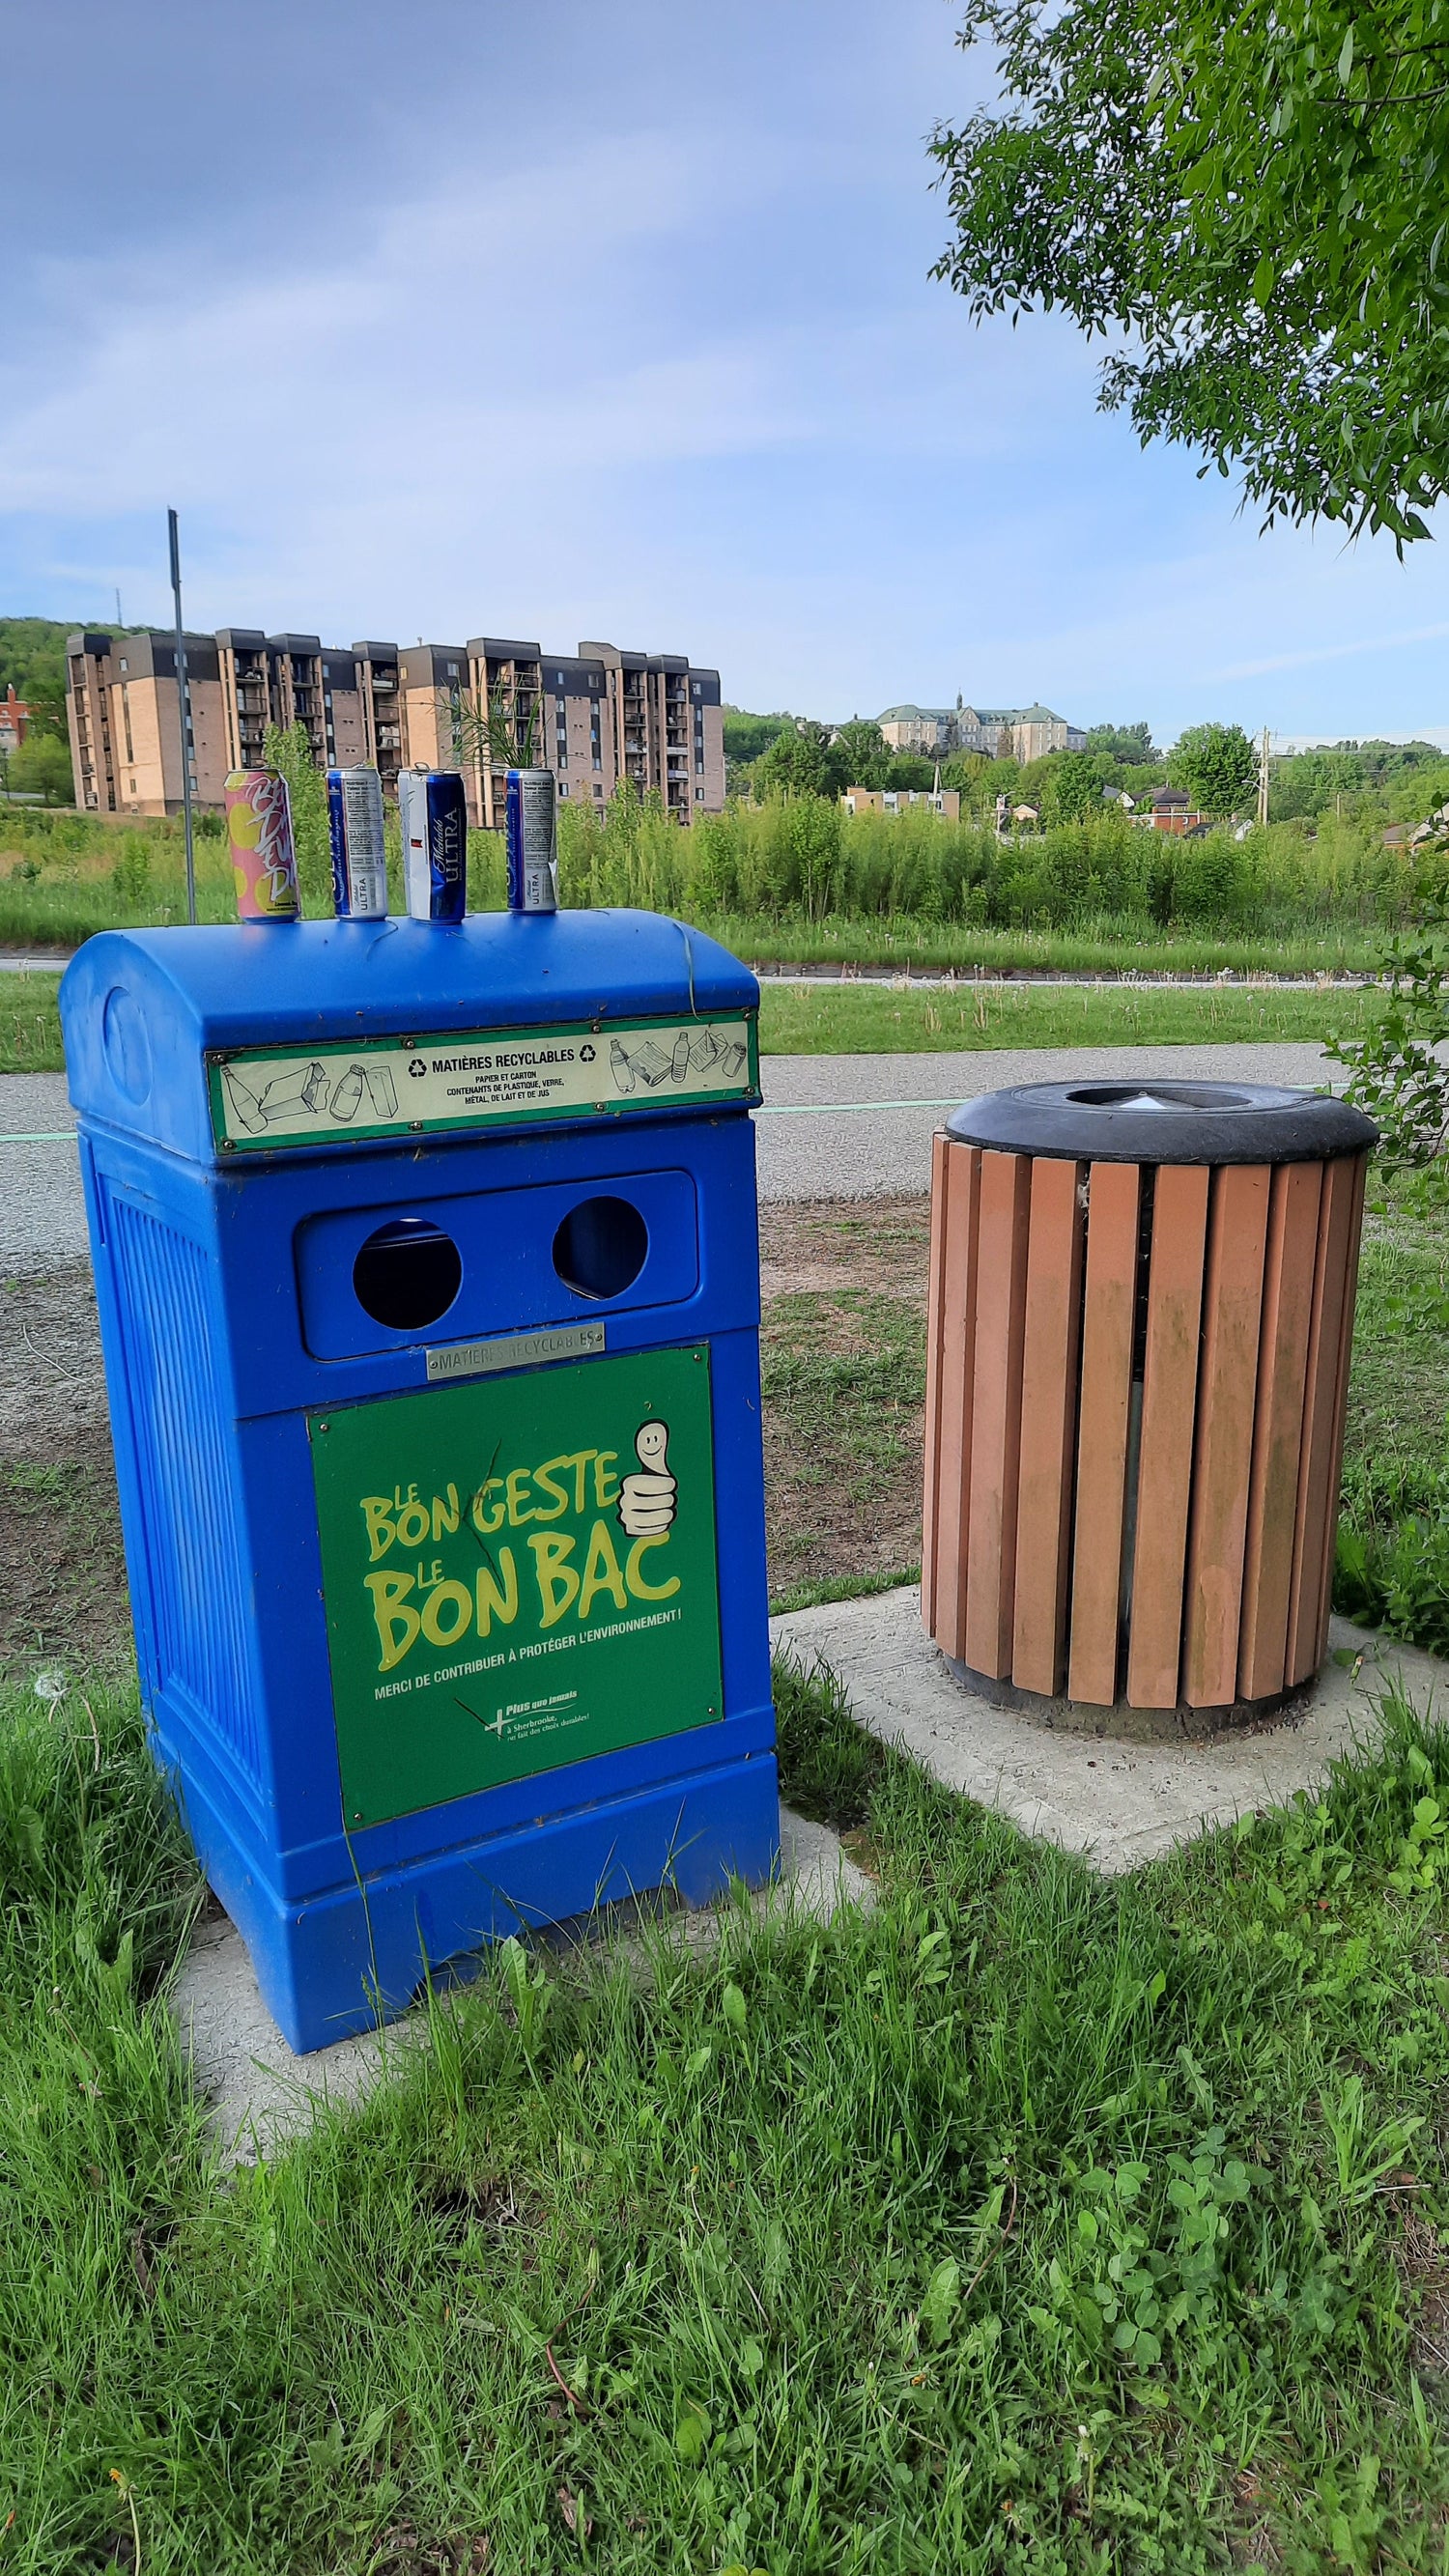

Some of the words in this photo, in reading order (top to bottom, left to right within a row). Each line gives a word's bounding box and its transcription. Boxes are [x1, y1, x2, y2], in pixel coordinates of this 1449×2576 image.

[444, 807, 459, 883] ULTRA
[358, 877, 368, 911] ULTRA
[432, 1056, 493, 1073] MATIÈRES
[496, 1049, 575, 1068] RECYCLABLES
[446, 1085, 492, 1096] CONTENANTS
[493, 1084, 502, 1092] DE
[503, 1081, 541, 1091] PLASTIQUE,
[542, 1078, 565, 1088] VERRE,
[475, 1073, 499, 1084] PAPIER
[501, 1073, 509, 1082] ET
[510, 1071, 537, 1081] CARTON
[465, 1093, 490, 1105] MÉTAL,
[491, 1093, 500, 1102] DE
[501, 1092, 516, 1101] LAIT
[517, 1091, 526, 1100] ET
[527, 1090, 536, 1099] DE
[537, 1090, 550, 1098] JUS
[360, 1482, 461, 1562] BON
[472, 1448, 622, 1534] GESTE
[394, 1484, 420, 1511] LE
[416, 1559, 445, 1590] LE
[363, 1546, 520, 1672] BON
[526, 1518, 682, 1629] BAC
[374, 1680, 412, 1701] MERCI
[415, 1673, 431, 1689] DE
[434, 1653, 505, 1684] CONTRIBUER
[508, 1648, 517, 1663] À
[519, 1635, 577, 1660] PROTÉGER
[505, 1702, 530, 1716] Plus
[531, 1699, 548, 1709] que
[549, 1690, 578, 1706] jamais
